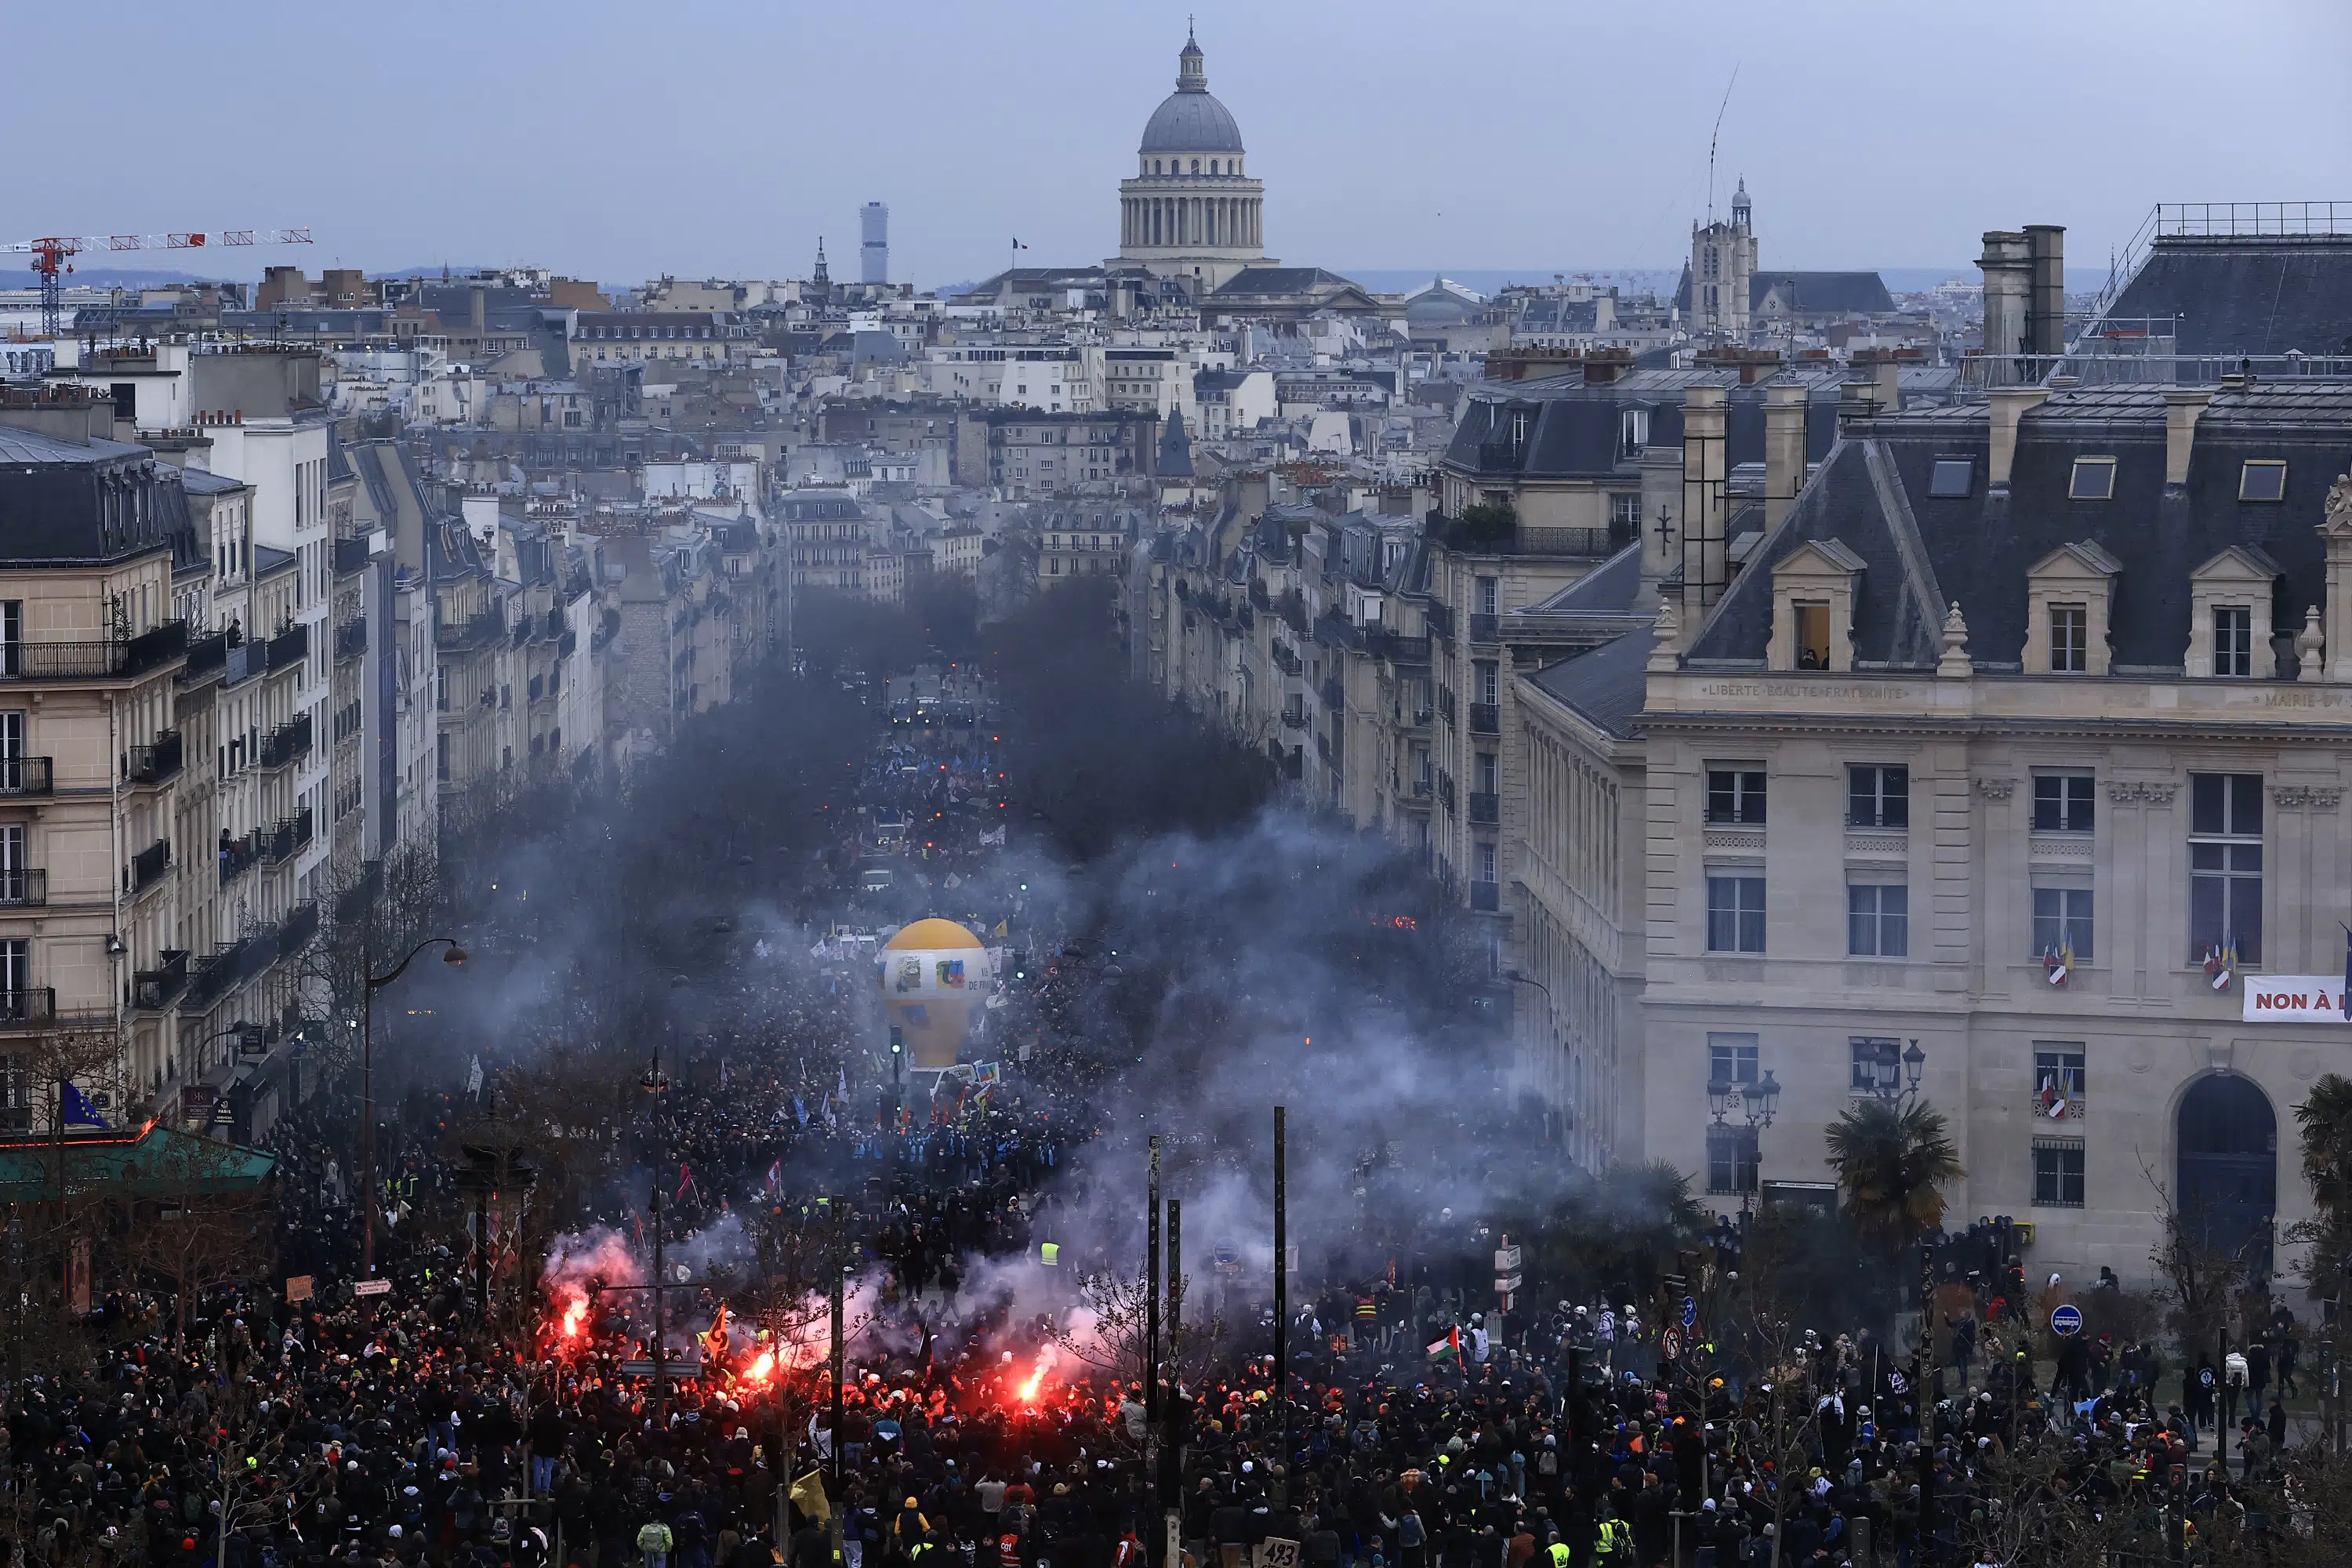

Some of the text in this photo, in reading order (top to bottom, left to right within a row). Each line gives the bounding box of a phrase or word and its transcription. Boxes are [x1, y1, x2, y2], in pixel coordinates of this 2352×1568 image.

[1708, 684, 1903, 699] LIBERTE EGALITE FRATERNITE
[2265, 693, 2316, 707] MAIRIE
[968, 981, 978, 990] DE
[2256, 993, 2307, 1010] NON
[2314, 989, 2332, 1010] À
[1000, 1542, 1012, 1552] cgt
